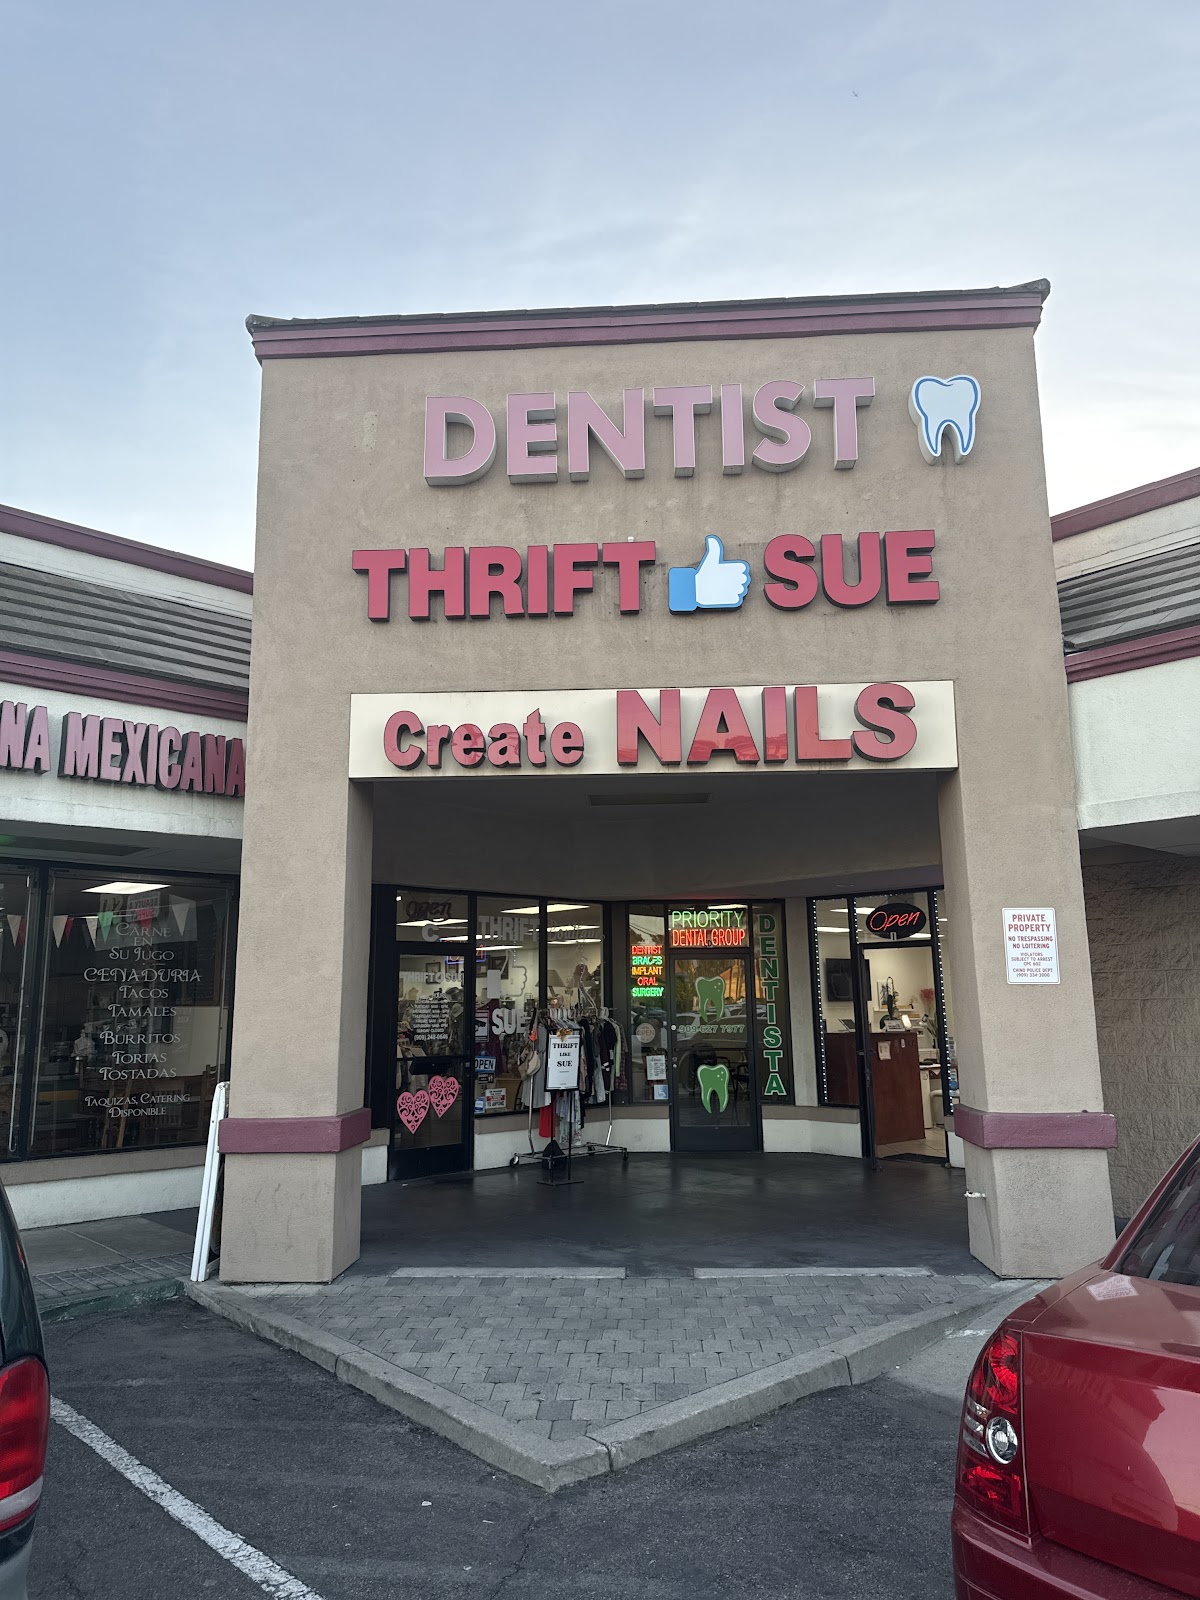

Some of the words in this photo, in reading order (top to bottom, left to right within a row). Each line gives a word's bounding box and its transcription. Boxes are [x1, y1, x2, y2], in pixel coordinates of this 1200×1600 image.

[423, 376, 876, 485] DENTIST
[352, 541, 656, 620] THRIFT
[763, 530, 940, 610] SUE
[384, 708, 585, 769] Create
[616, 683, 918, 765] NAILS
[58, 711, 245, 797] MEXICANA
[671, 910, 744, 928] PRIORITY
[870, 911, 921, 932] Open
[1012, 914, 1046, 922] PRIVATE
[115, 922, 171, 937] CARNE
[478, 915, 540, 941] THRIFT
[1008, 924, 1051, 932] PROPERTY
[672, 929, 708, 946] DENTAL
[711, 928, 746, 946] GROUP
[109, 946, 130, 960] SU
[134, 947, 175, 961] JUGO
[631, 945, 663, 955] DENTIST
[631, 966, 664, 976] IMPLANT
[637, 976, 658, 986] ORAL
[119, 985, 169, 999] TACOS
[631, 986, 665, 998] SURGERY
[107, 1003, 177, 1017] TAMALES
[758, 913, 788, 1096] DENTISTA
[492, 1008, 527, 1035] SUE
[100, 1030, 181, 1045] BURRITOS
[111, 1050, 167, 1064] TORTAS
[99, 1067, 177, 1080] TOSTADAS
[140, 1093, 191, 1104] CATERING
[108, 1107, 167, 1118] DISPONIBLE
